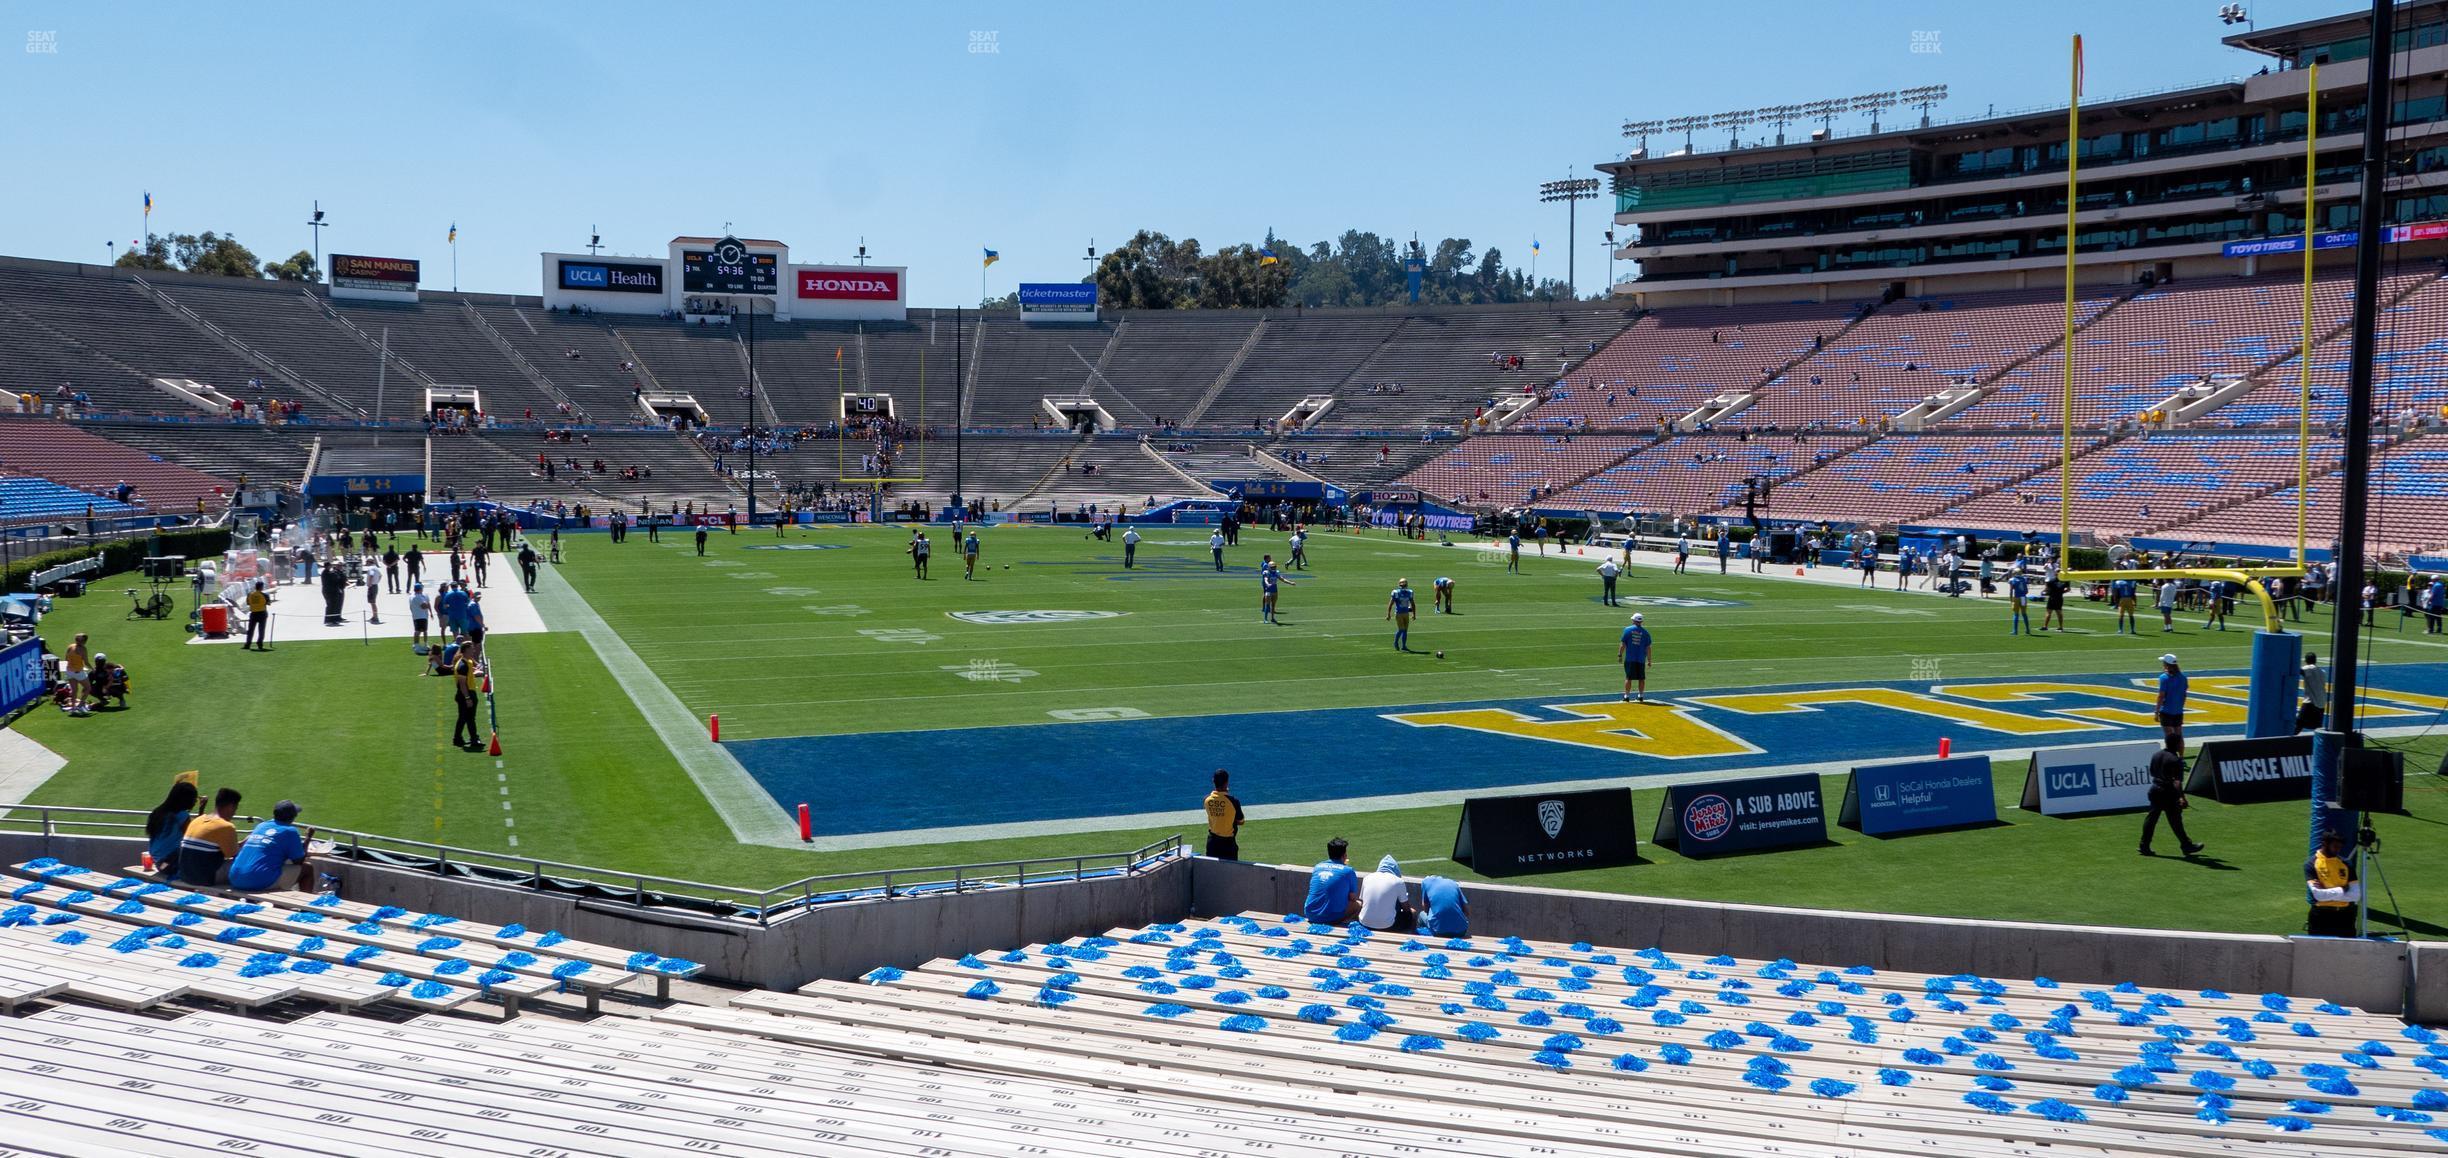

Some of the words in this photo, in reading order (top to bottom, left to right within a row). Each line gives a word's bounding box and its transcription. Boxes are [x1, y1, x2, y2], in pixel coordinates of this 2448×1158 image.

[2230, 244, 2262, 254] TOYO
[2263, 240, 2296, 252] TIRES
[350, 259, 372, 269] SAN
[374, 261, 416, 272] MANUEL
[718, 266, 744, 275] 59:36
[570, 270, 602, 282] UCLA
[610, 271, 656, 286] Health
[806, 279, 890, 292] HONDA
[1022, 288, 1090, 298] ticketmaster
[858, 398, 874, 410] 40
[698, 516, 726, 527] TCL
[1424, 515, 1446, 528] TOYO
[1446, 516, 1473, 529] TIRES
[2219, 758, 2280, 783] MUSCLE
[1900, 781, 1924, 794] SoCal
[1925, 778, 1952, 790] Honda
[1952, 776, 1983, 788] Dealers
[2052, 772, 2091, 790] UCLA
[1208, 800, 1226, 808] CSC
[1736, 798, 1745, 816] A
[1748, 795, 1773, 815] SUB
[1690, 802, 1726, 821] Jersey
[1548, 820, 1558, 832] 12
[1758, 816, 1819, 831] jerseymikes.com
[1518, 849, 1594, 864] NETWORKS
[43, 1038, 73, 1046] 103
[122, 1051, 153, 1059] 104
[28, 1065, 63, 1073] 105
[201, 1065, 234, 1073] 105
[356, 1063, 385, 1071] 105
[120, 1080, 156, 1089] 106
[291, 1080, 322, 1088] 106
[212, 1095, 249, 1105] 107
[381, 1093, 414, 1101] 107
[533, 1091, 560, 1099] 107
[5, 1101, 46, 1111] 107
[316, 1114, 353, 1123] 108
[477, 1110, 511, 1118] 108
[105, 1119, 148, 1130] 108
[714, 1119, 746, 1127] 109
[410, 1129, 448, 1139] 109
[575, 1125, 610, 1134] 109
[815, 1133, 849, 1141] 110
[218, 1139, 260, 1151] 109
[685, 1140, 720, 1150] 110
[1018, 1146, 1049, 1154] 111
[1245, 1141, 1274, 1149] 112
[529, 1148, 569, 1158] 110
[919, 1148, 952, 1157] 111
